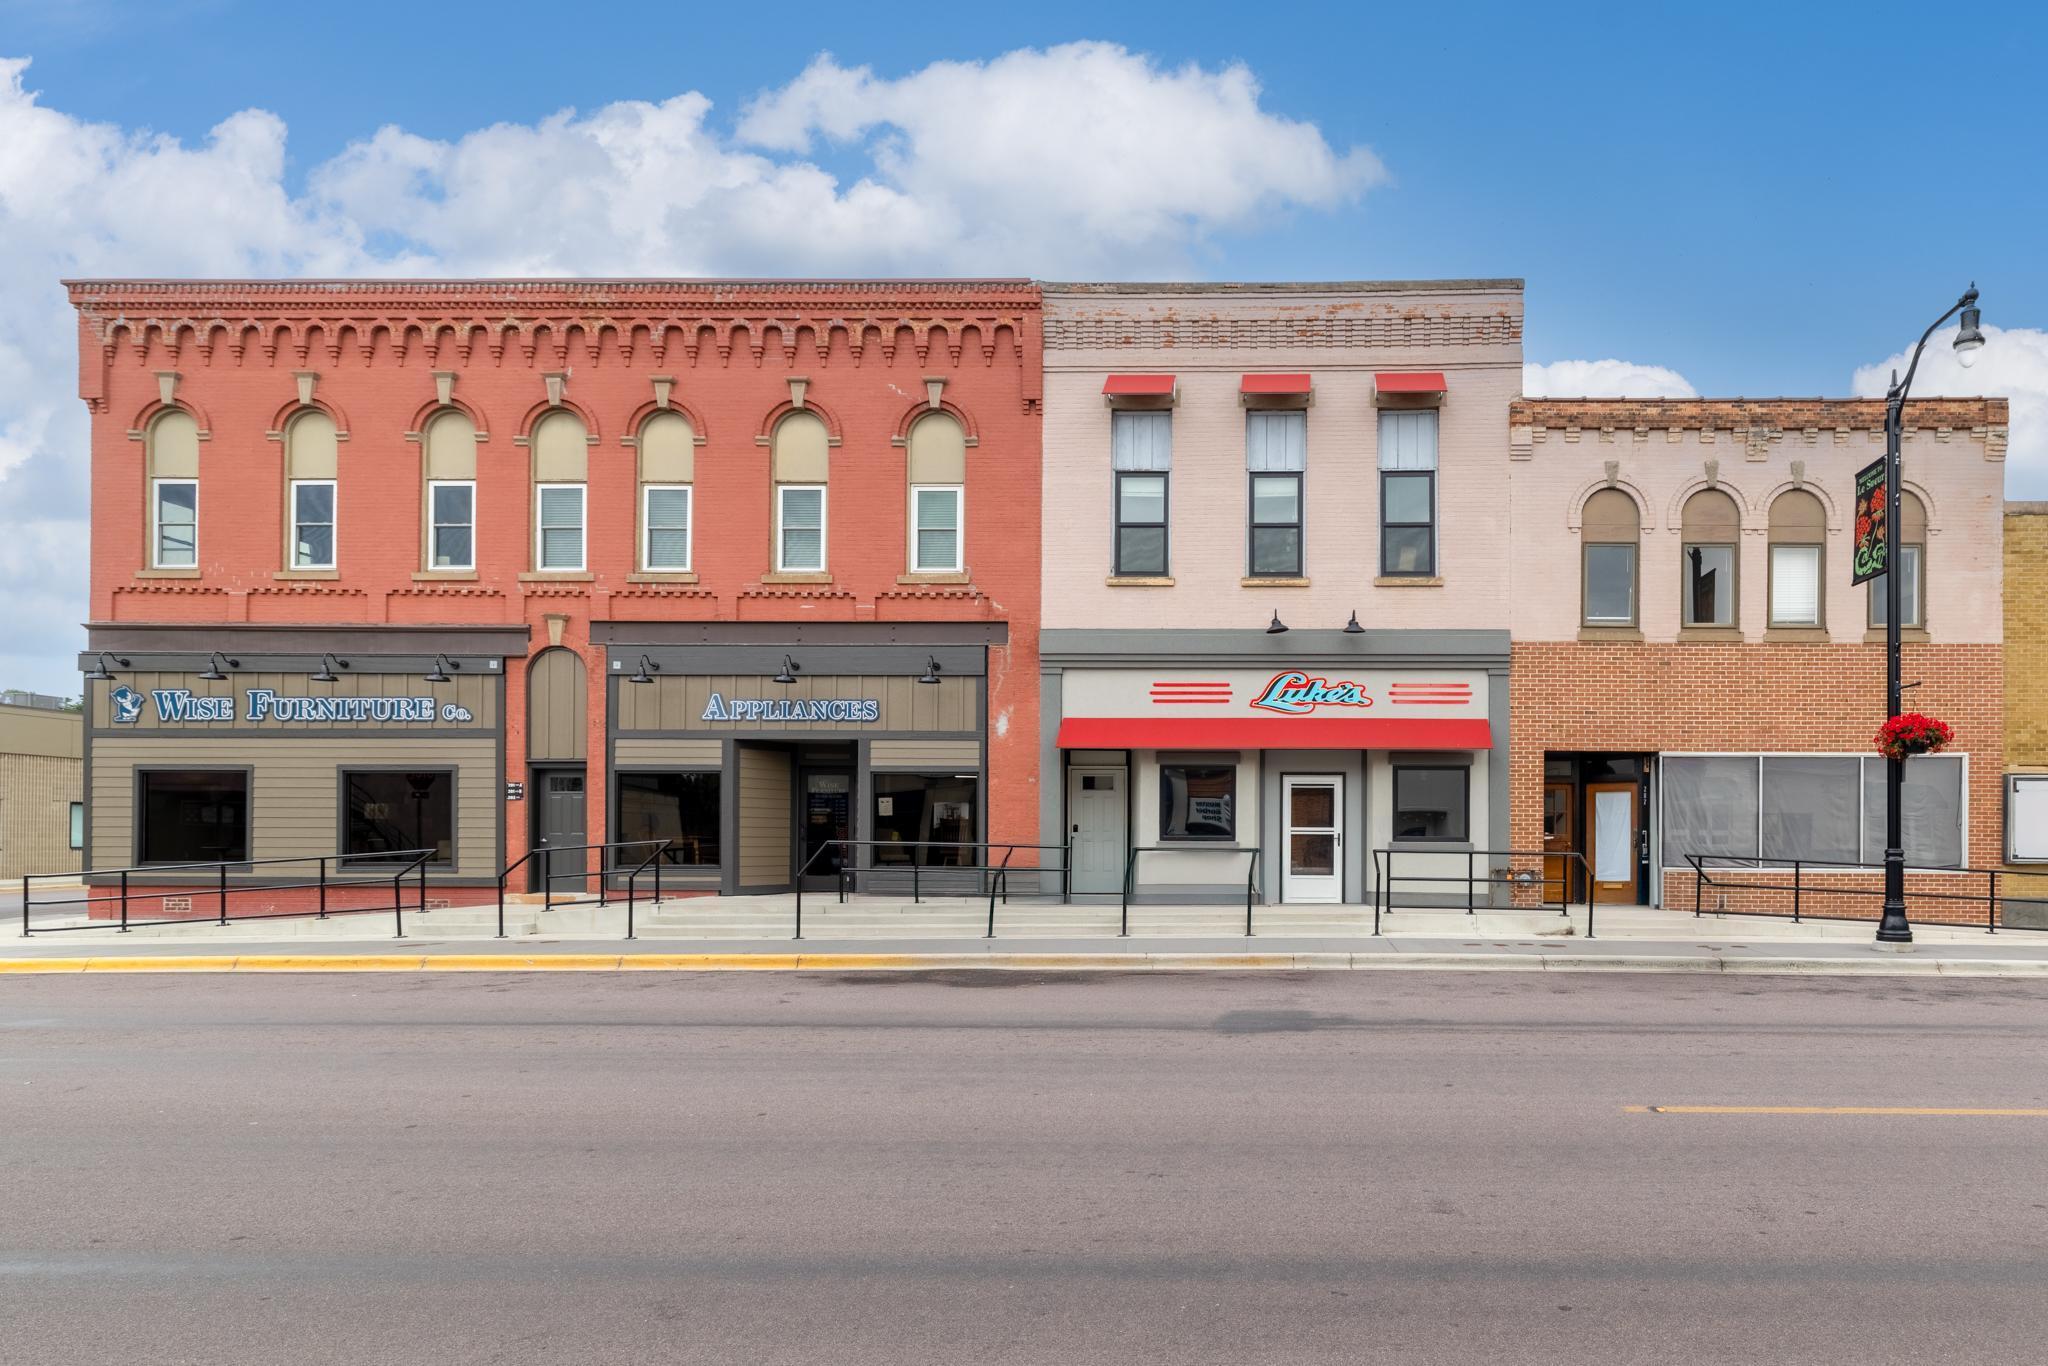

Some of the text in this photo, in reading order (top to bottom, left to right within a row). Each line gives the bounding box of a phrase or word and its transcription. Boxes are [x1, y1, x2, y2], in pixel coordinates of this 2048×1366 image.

[1857, 485, 1865, 496] Le
[152, 690, 233, 720] WISE
[247, 690, 434, 721] FURNITURE
[702, 693, 878, 720] APPLIANCES
[1252, 672, 1371, 713] Luke's
